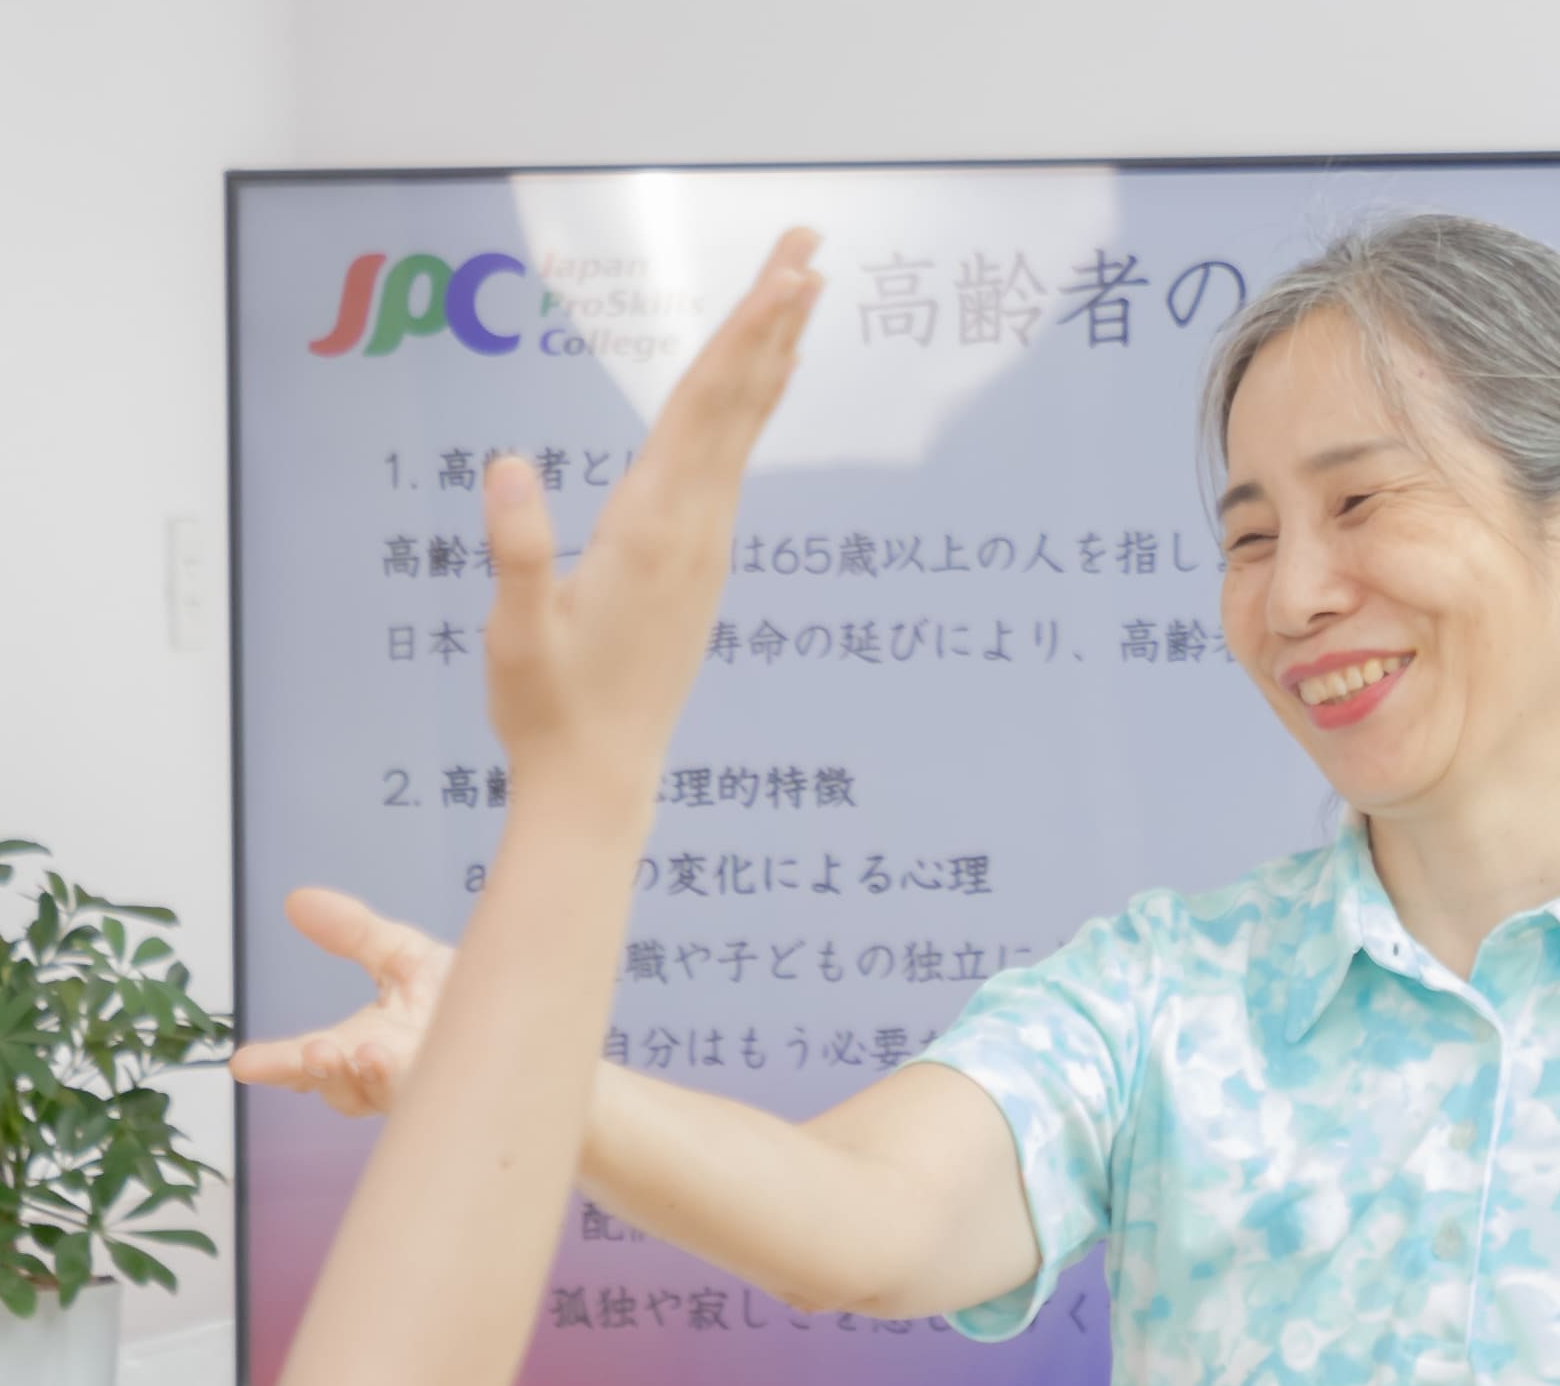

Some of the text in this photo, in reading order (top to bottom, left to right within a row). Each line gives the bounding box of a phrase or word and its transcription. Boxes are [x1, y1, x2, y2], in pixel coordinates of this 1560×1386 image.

[541, 251, 649, 286] Japan
[539, 325, 681, 363] College
[438, 446, 634, 492] 高者と
[614, 937, 1068, 985] 職や子どもの独立に
